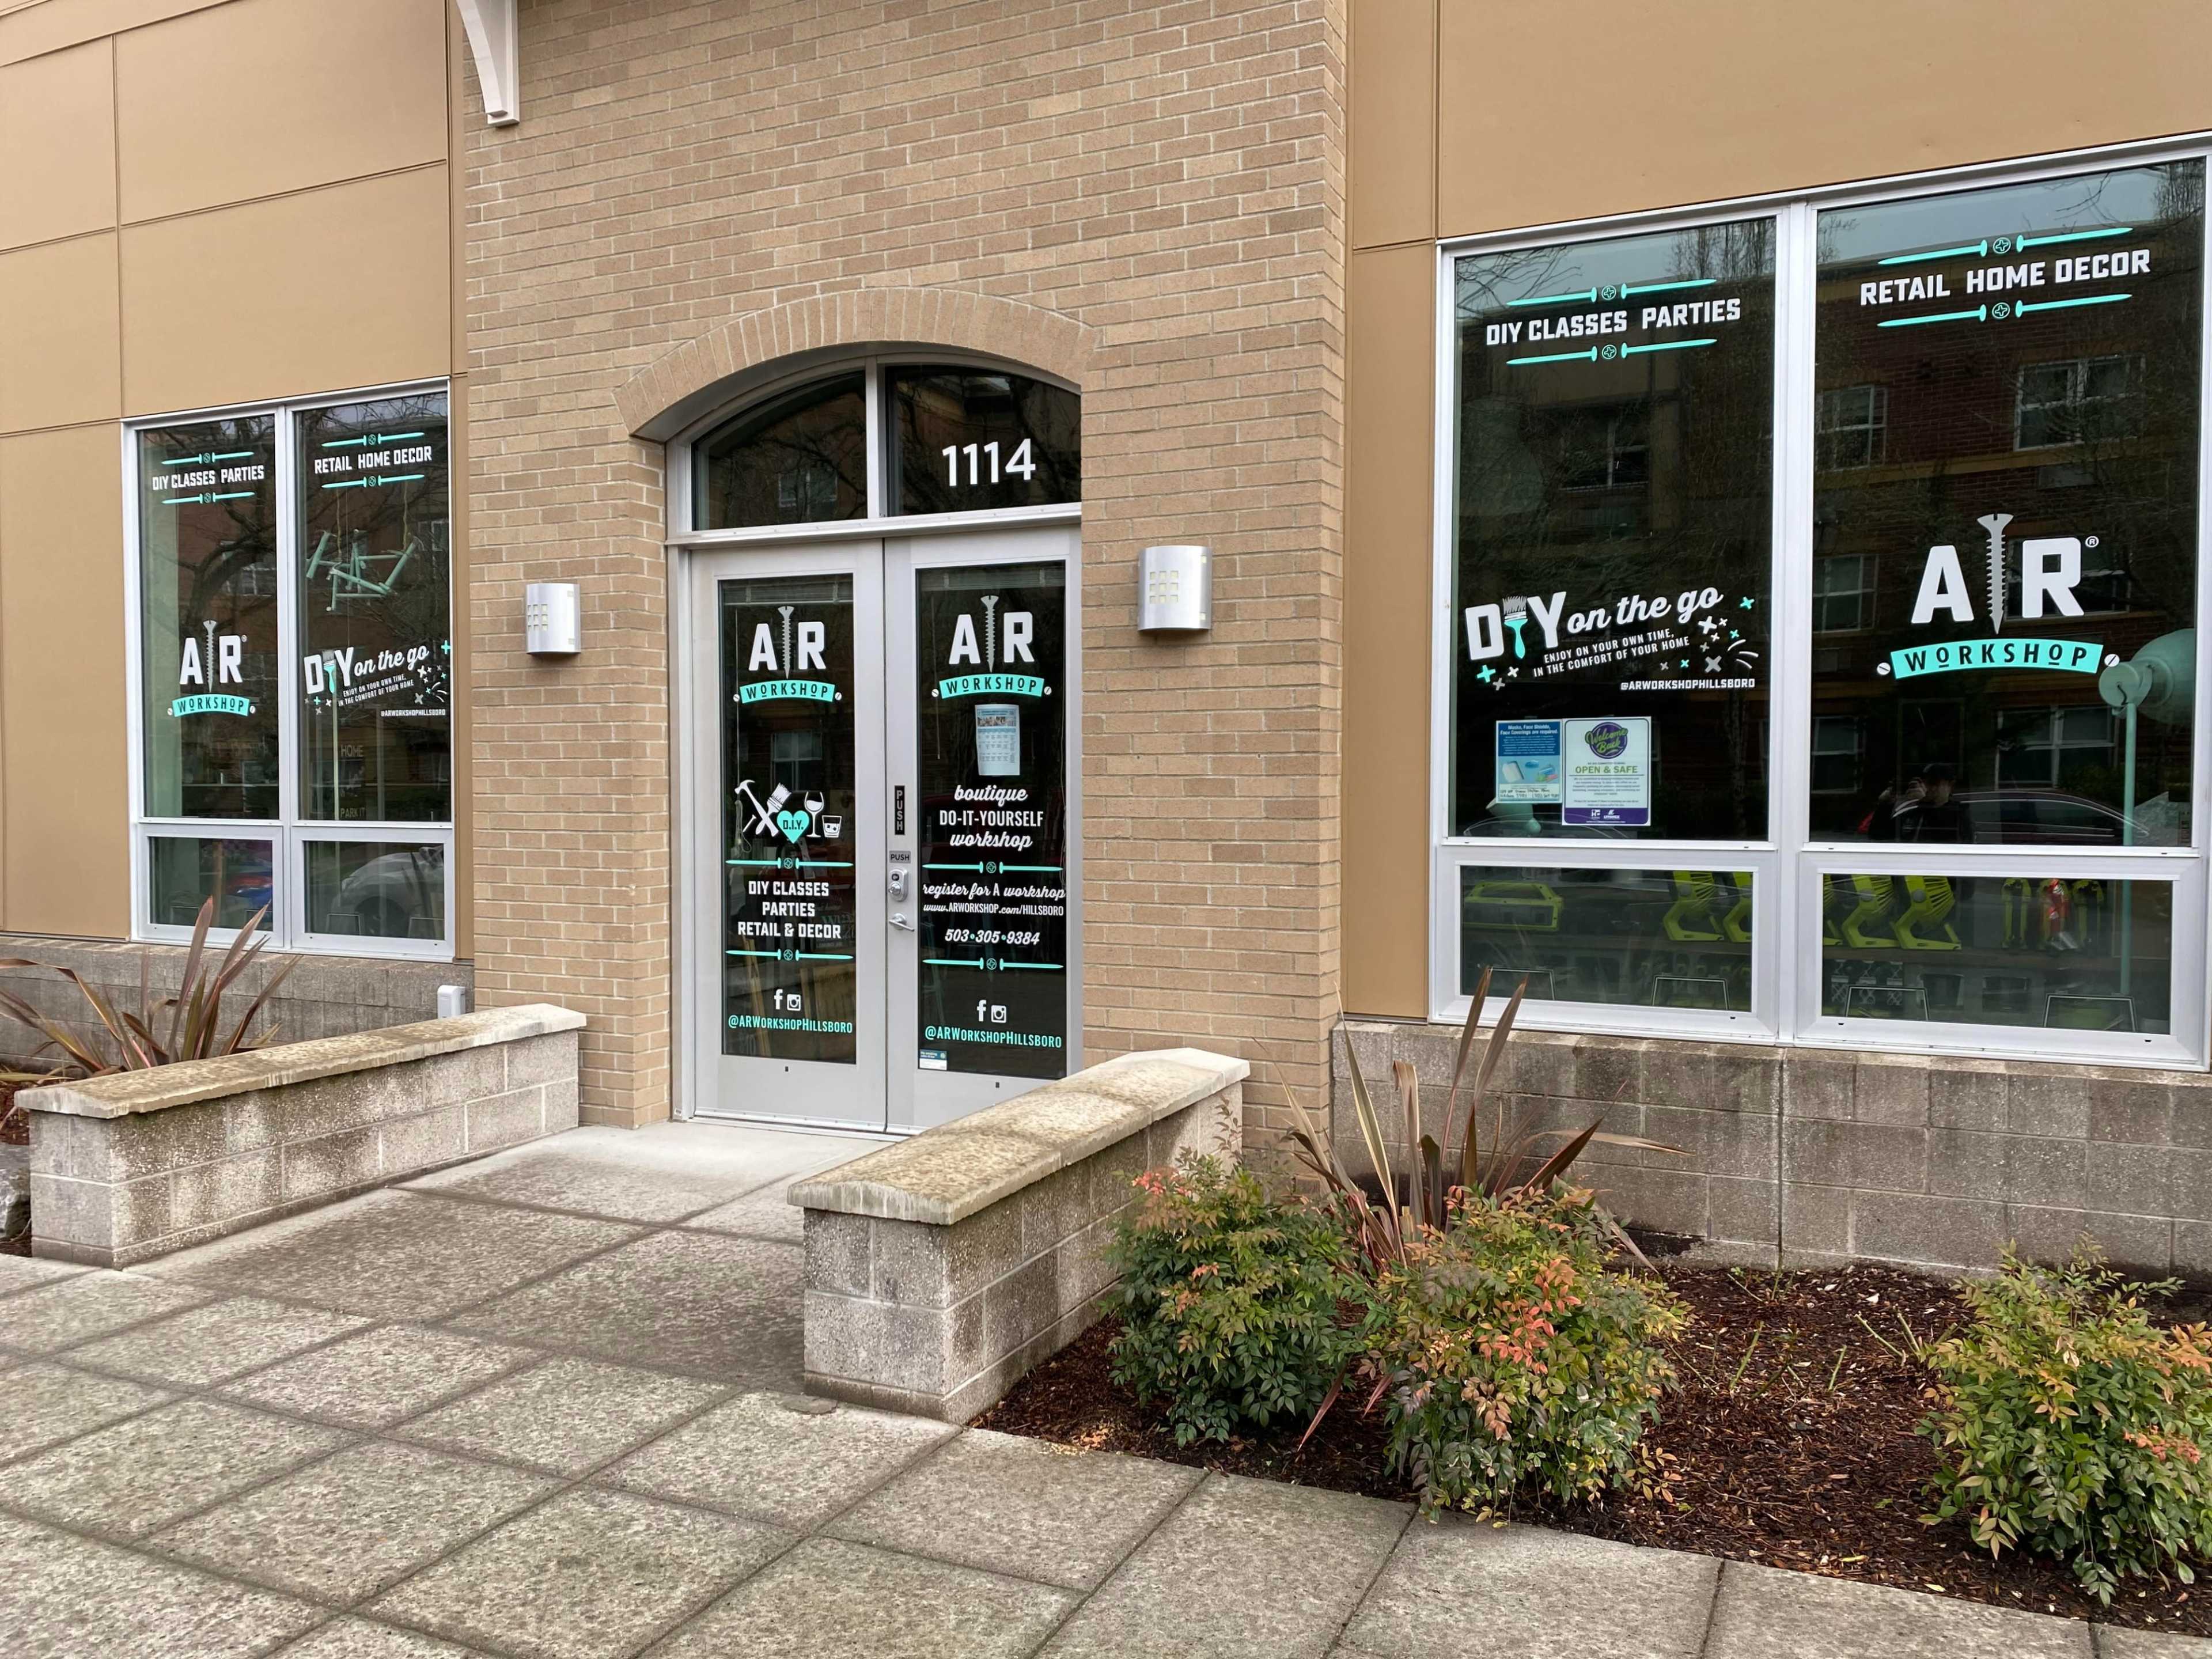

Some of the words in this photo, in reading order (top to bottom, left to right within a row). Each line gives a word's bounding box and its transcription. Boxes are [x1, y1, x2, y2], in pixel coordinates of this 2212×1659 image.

[1861, 274, 1950, 305] RETAIL
[1967, 262, 2046, 294] HOME
[2055, 249, 2150, 283] DECOR
[1486, 321, 1522, 346] DIY
[1528, 310, 1627, 342] CLASSES
[1642, 298, 1740, 329] PARTIES
[315, 455, 353, 474] RETAIL
[358, 450, 391, 469] HOME
[393, 446, 432, 465] DECOR
[942, 438, 1036, 486] 1114
[152, 475, 169, 491] DIY
[171, 470, 215, 488] CLASSES
[221, 465, 264, 484] PARTIES
[1465, 591, 1567, 660] DIY
[1567, 608, 1612, 634] on
[1616, 594, 1671, 625] the
[1677, 587, 1724, 623] go
[1543, 649, 1572, 664] ENJOY
[1576, 646, 1589, 657] ON
[1592, 641, 1619, 653] YOUR
[1623, 635, 1644, 647] OWN
[1647, 628, 1675, 642] TIME,
[1533, 668, 1544, 677] IN
[1546, 662, 1565, 675] THE
[1568, 653, 1612, 671] COMFORT
[1616, 650, 1628, 660] OF
[1631, 643, 1658, 657] YOUR
[1661, 636, 1690, 650] HOME
[1904, 643, 2088, 672] WORKSHOP
[304, 646, 354, 695] DIY
[354, 658, 376, 676] on
[378, 649, 404, 671] the
[407, 645, 430, 671] go
[343, 688, 357, 698] ENJOY
[367, 681, 380, 691] YOUR
[381, 677, 392, 687] OWN
[345, 697, 354, 705] THE
[355, 690, 377, 702] COMFORT
[385, 685, 399, 694] YOUR
[400, 679, 414, 689] HOME
[746, 681, 828, 699] WORKSHOP
[946, 676, 1037, 695] WORKSHOP
[1620, 678, 1756, 691] @ARWORKSHOPHILLSBORO
[177, 697, 244, 713] WORKSHOP
[1585, 728, 1628, 744] Welcome
[1597, 737, 1623, 753] Back
[340, 744, 363, 757] HOME
[1575, 766, 1601, 774] OPEN
[1603, 766, 1611, 774] &
[1613, 765, 1638, 774] SAFE
[954, 785, 1028, 807] boutique
[782, 820, 804, 830] D.I.Y.
[939, 809, 1043, 827] DO-IT-YOURSELF
[950, 831, 1033, 851] workshop
[748, 881, 769, 895] DIY
[772, 881, 830, 896] CLASSES
[922, 882, 969, 899] register
[968, 882, 991, 900] for
[993, 882, 1001, 896] A
[1003, 885, 1066, 901] workshop
[762, 902, 816, 917] PARTIES
[923, 902, 1064, 916] www.ARWORKSHOP.com/HILLSBORO
[737, 921, 781, 937] RETAIL
[784, 922, 794, 937] &
[798, 923, 842, 939] DECOR
